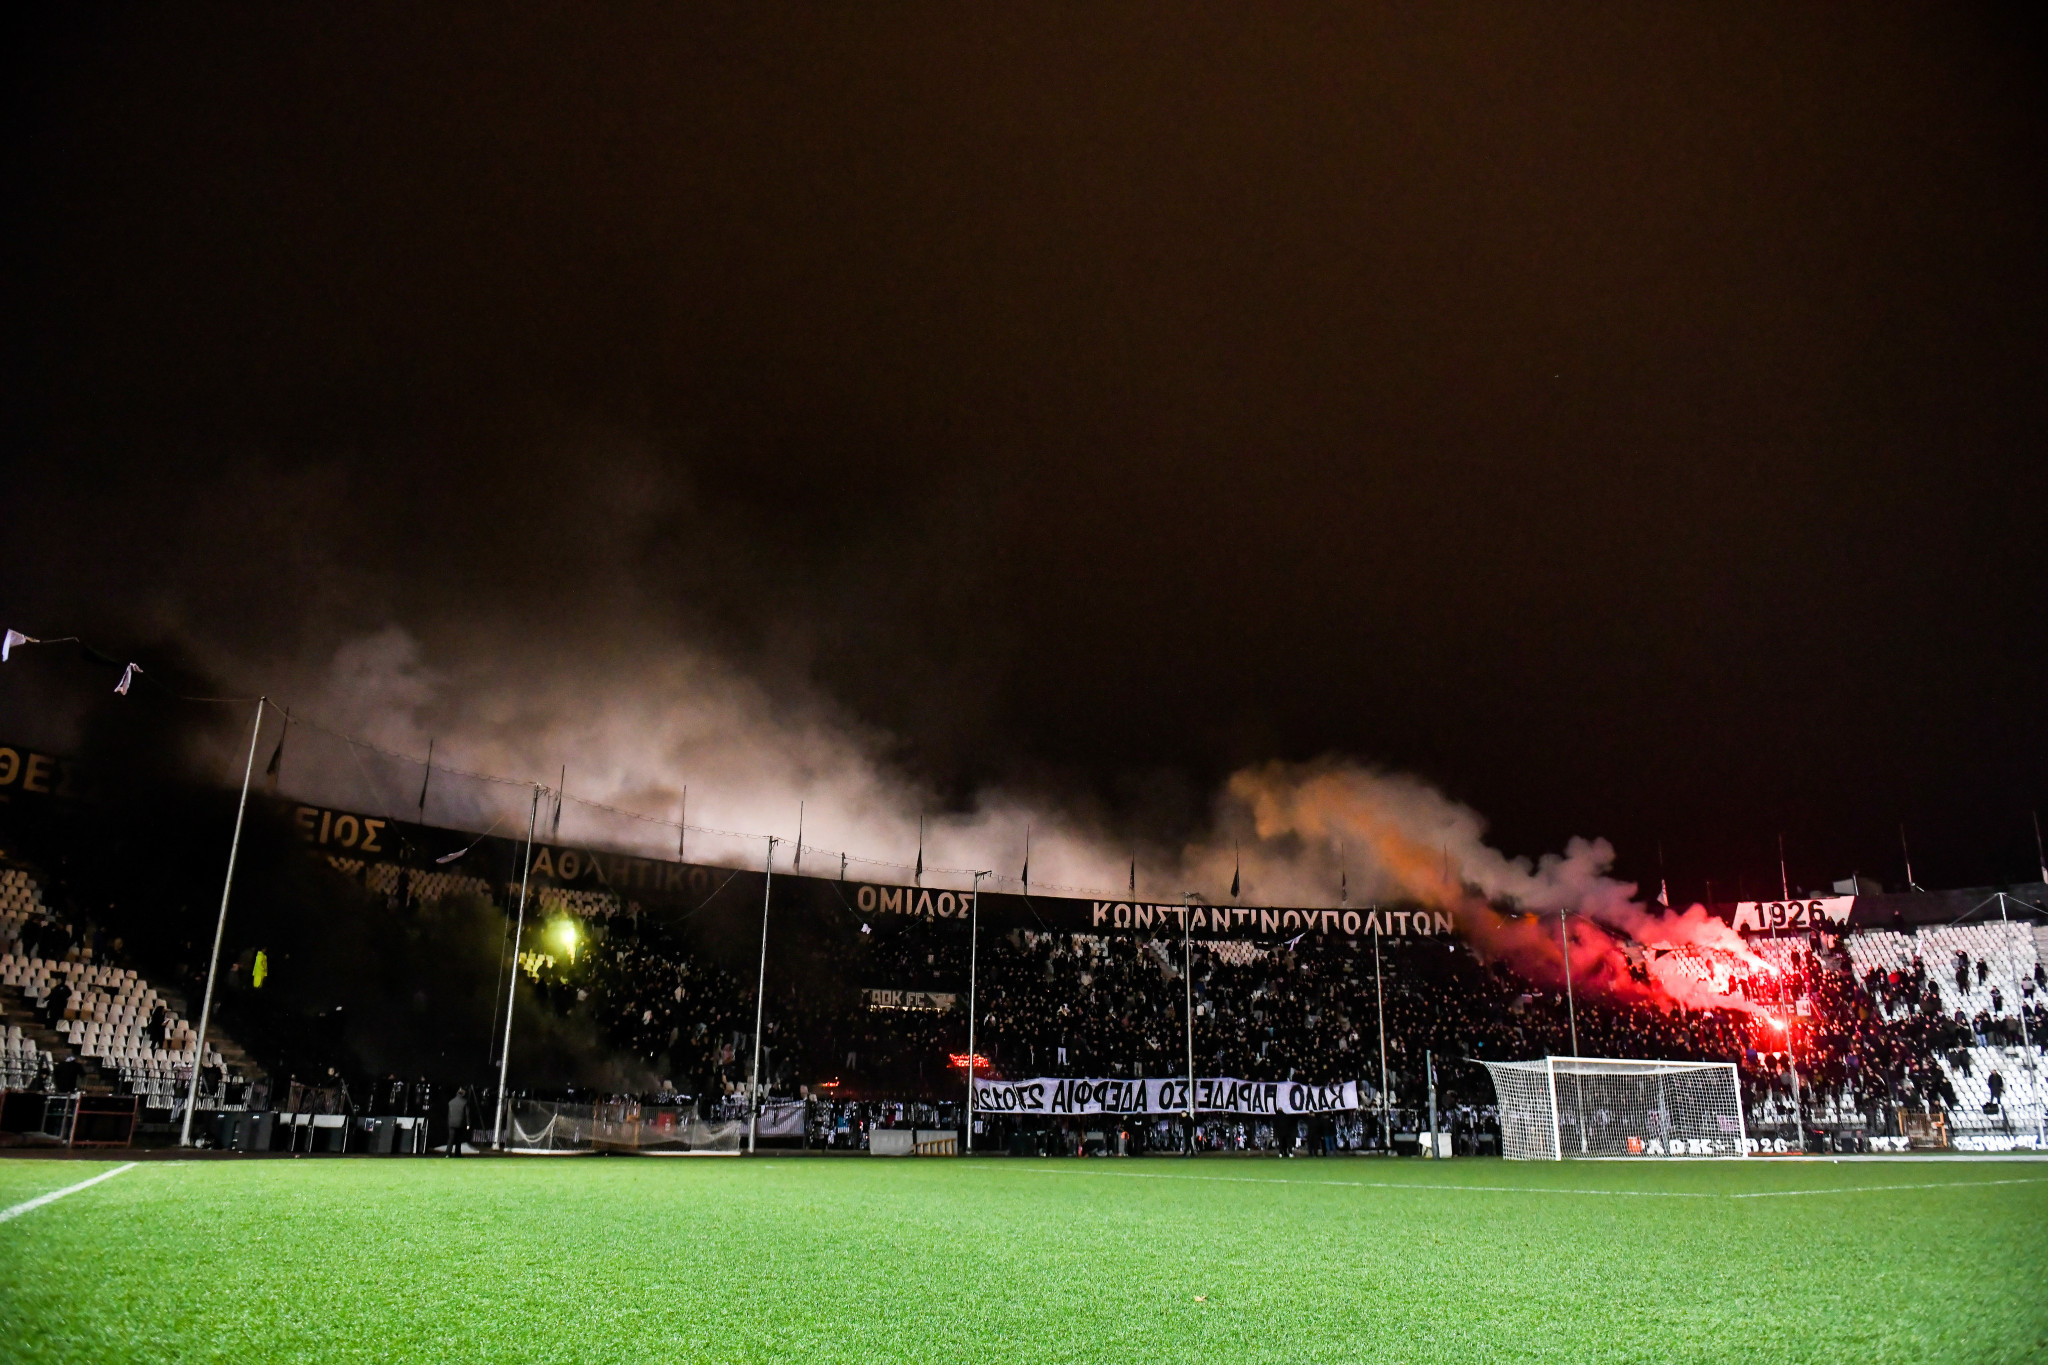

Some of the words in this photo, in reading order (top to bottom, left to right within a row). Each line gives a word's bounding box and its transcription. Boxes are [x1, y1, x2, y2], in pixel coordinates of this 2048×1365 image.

[530, 846, 720, 892] ΑΘΛΗΤΙΚΟ
[857, 885, 975, 919] ΟΜΙΛΟΣ
[1754, 901, 1825, 928] 1926
[862, 989, 903, 1006] AOK
[1636, 1137, 1713, 1155] AOK
